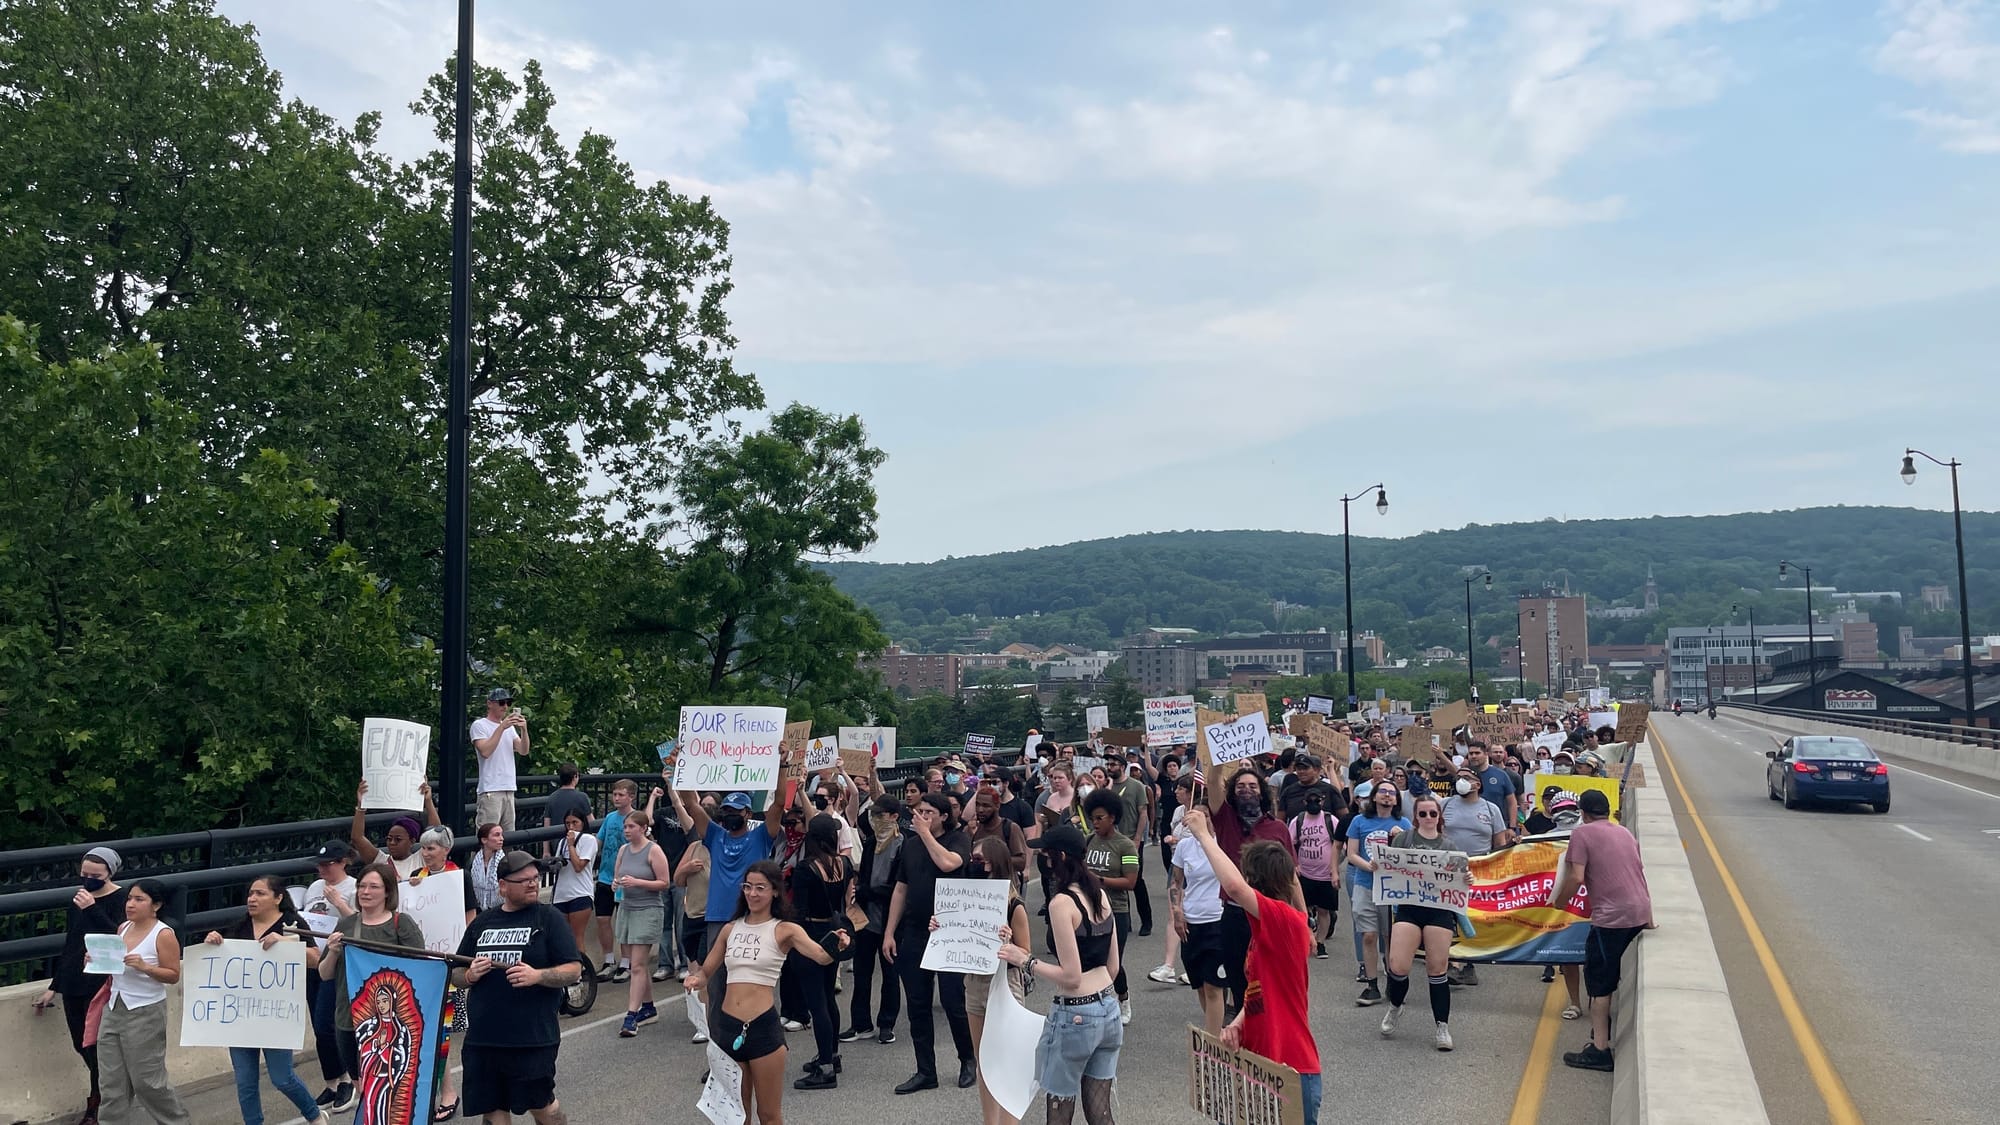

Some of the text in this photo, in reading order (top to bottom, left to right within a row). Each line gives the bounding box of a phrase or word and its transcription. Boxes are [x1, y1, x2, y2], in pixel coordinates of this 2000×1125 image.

[1279, 637, 1324, 645] LEHIGH
[1827, 701, 1873, 709] RIVERPORT
[691, 711, 778, 735] OUR FRIENDS
[787, 728, 806, 739] WILL
[969, 735, 984, 743] STOP
[1209, 723, 1255, 744] Bring
[366, 727, 428, 773] FUCK
[690, 738, 717, 759] OUR
[721, 740, 773, 762] Neighbors
[806, 746, 834, 760] FASCISM
[1216, 736, 1265, 763] Back!!!
[1220, 738, 1253, 752] Them
[808, 756, 830, 768] AHEAD
[676, 758, 686, 787] OFF
[696, 764, 770, 785] OUR TOWN
[367, 768, 425, 803] ICE
[1086, 849, 1111, 867] LOVE
[1377, 845, 1400, 864] Hey
[1434, 871, 1454, 882] my
[1380, 876, 1416, 900] Foot
[1440, 889, 1466, 908] ASS
[1508, 880, 1539, 898] THE
[936, 899, 960, 911] CANNOT
[494, 930, 529, 944] JUSTICE
[734, 933, 761, 945] FUCK
[198, 956, 301, 990] ICE OUT
[192, 994, 300, 1023] OF BETHLEHEM
[1192, 1030, 1231, 1064] DONALD
[1244, 1059, 1284, 1097] TRUMP
